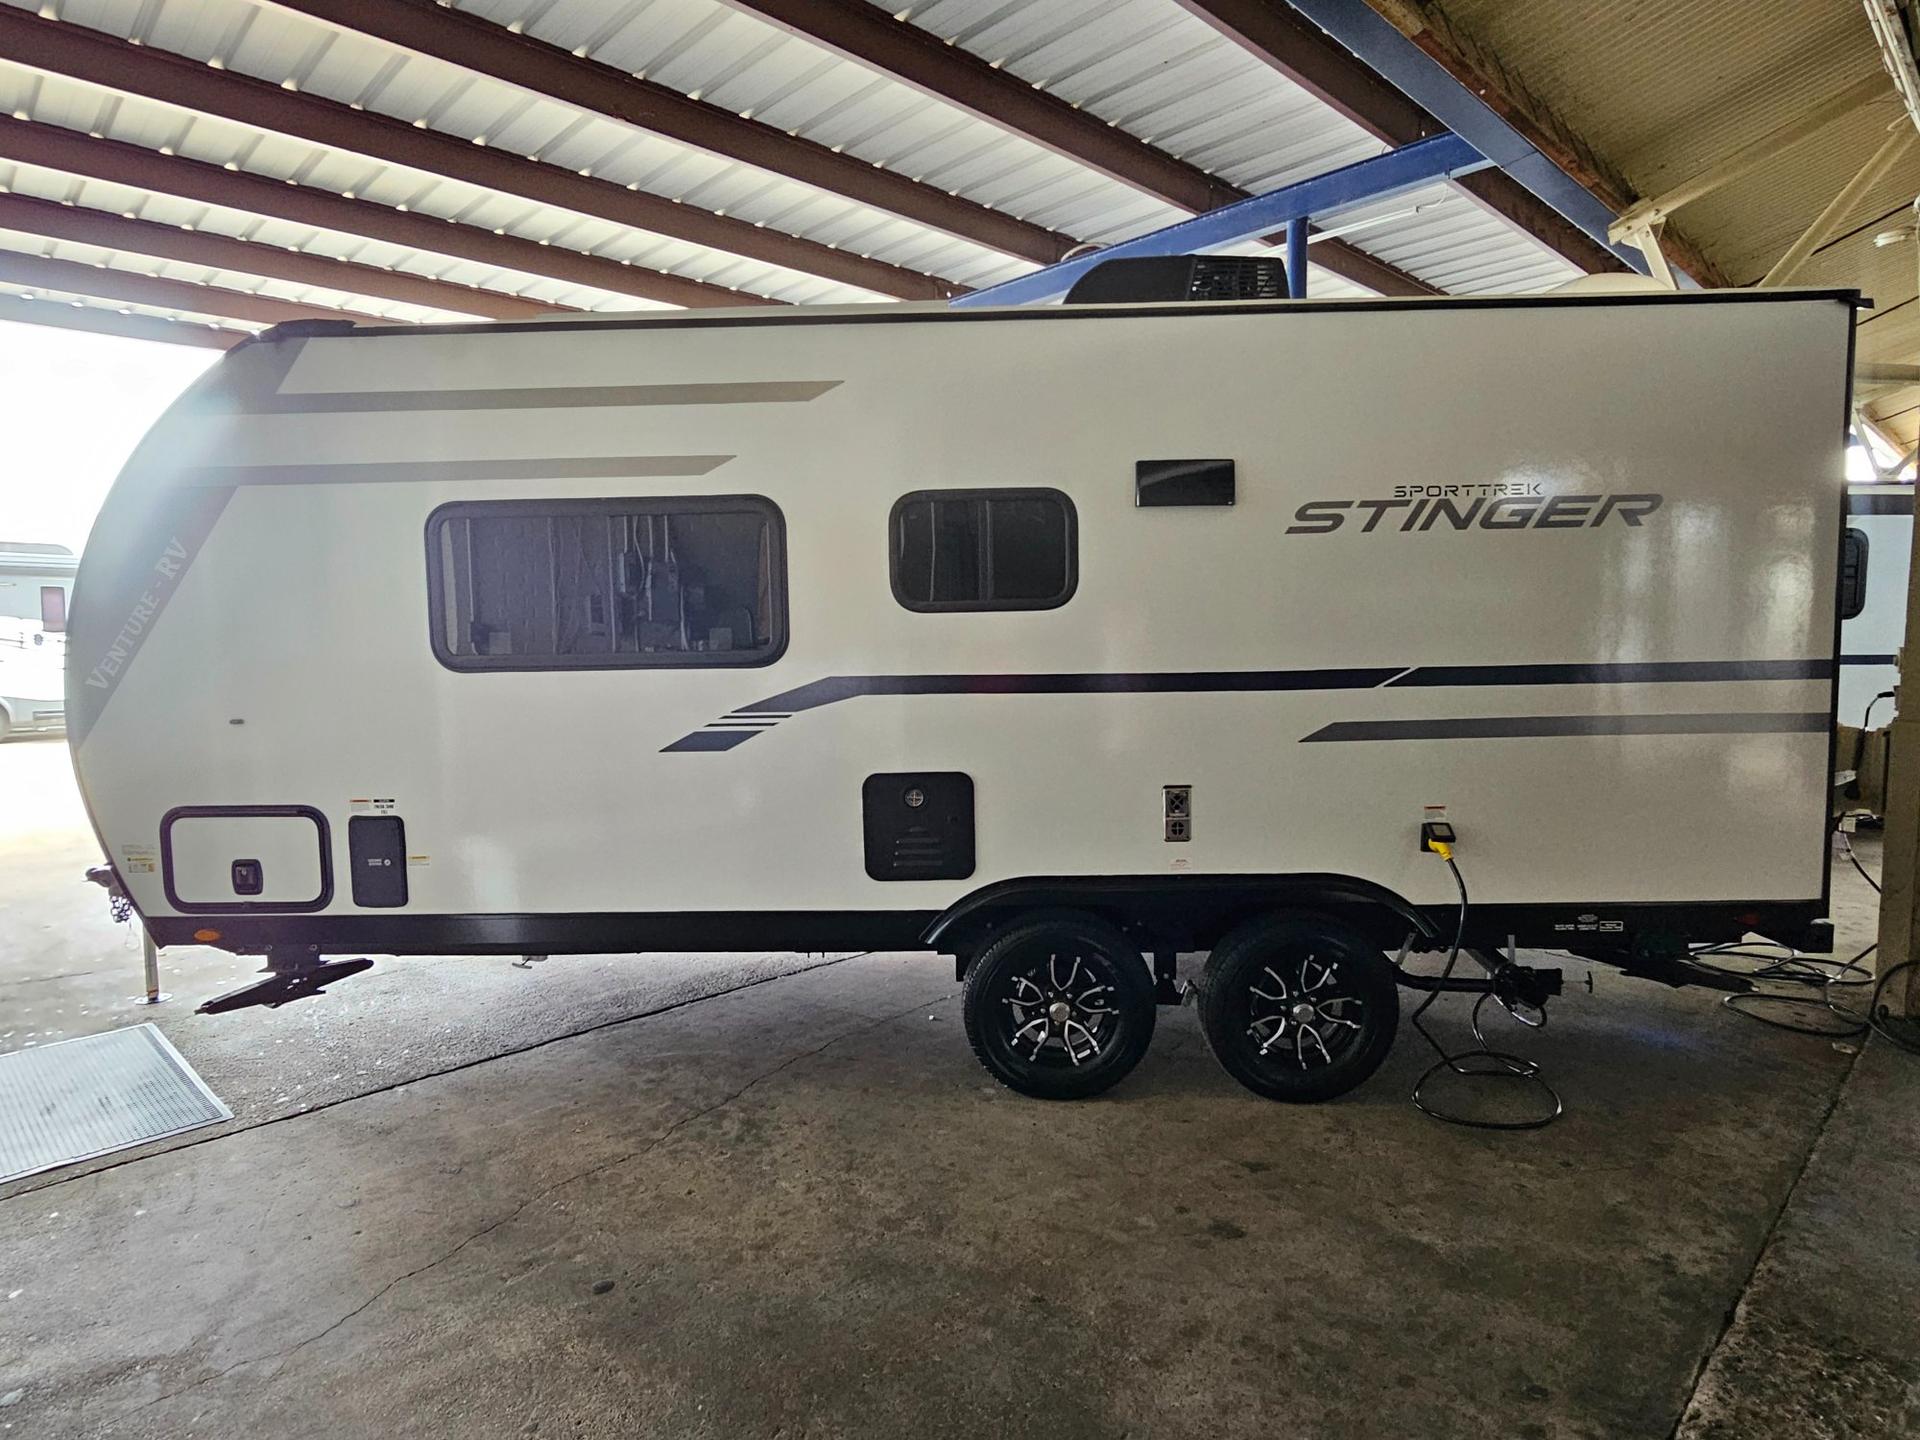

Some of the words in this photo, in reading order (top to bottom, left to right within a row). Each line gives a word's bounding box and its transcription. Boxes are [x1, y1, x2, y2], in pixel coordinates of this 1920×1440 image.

[1394, 483, 1543, 498] SPORTTREK
[1285, 494, 1664, 534] STINGER
[85, 590, 160, 690] VENTURE
[154, 536, 187, 579] RV
